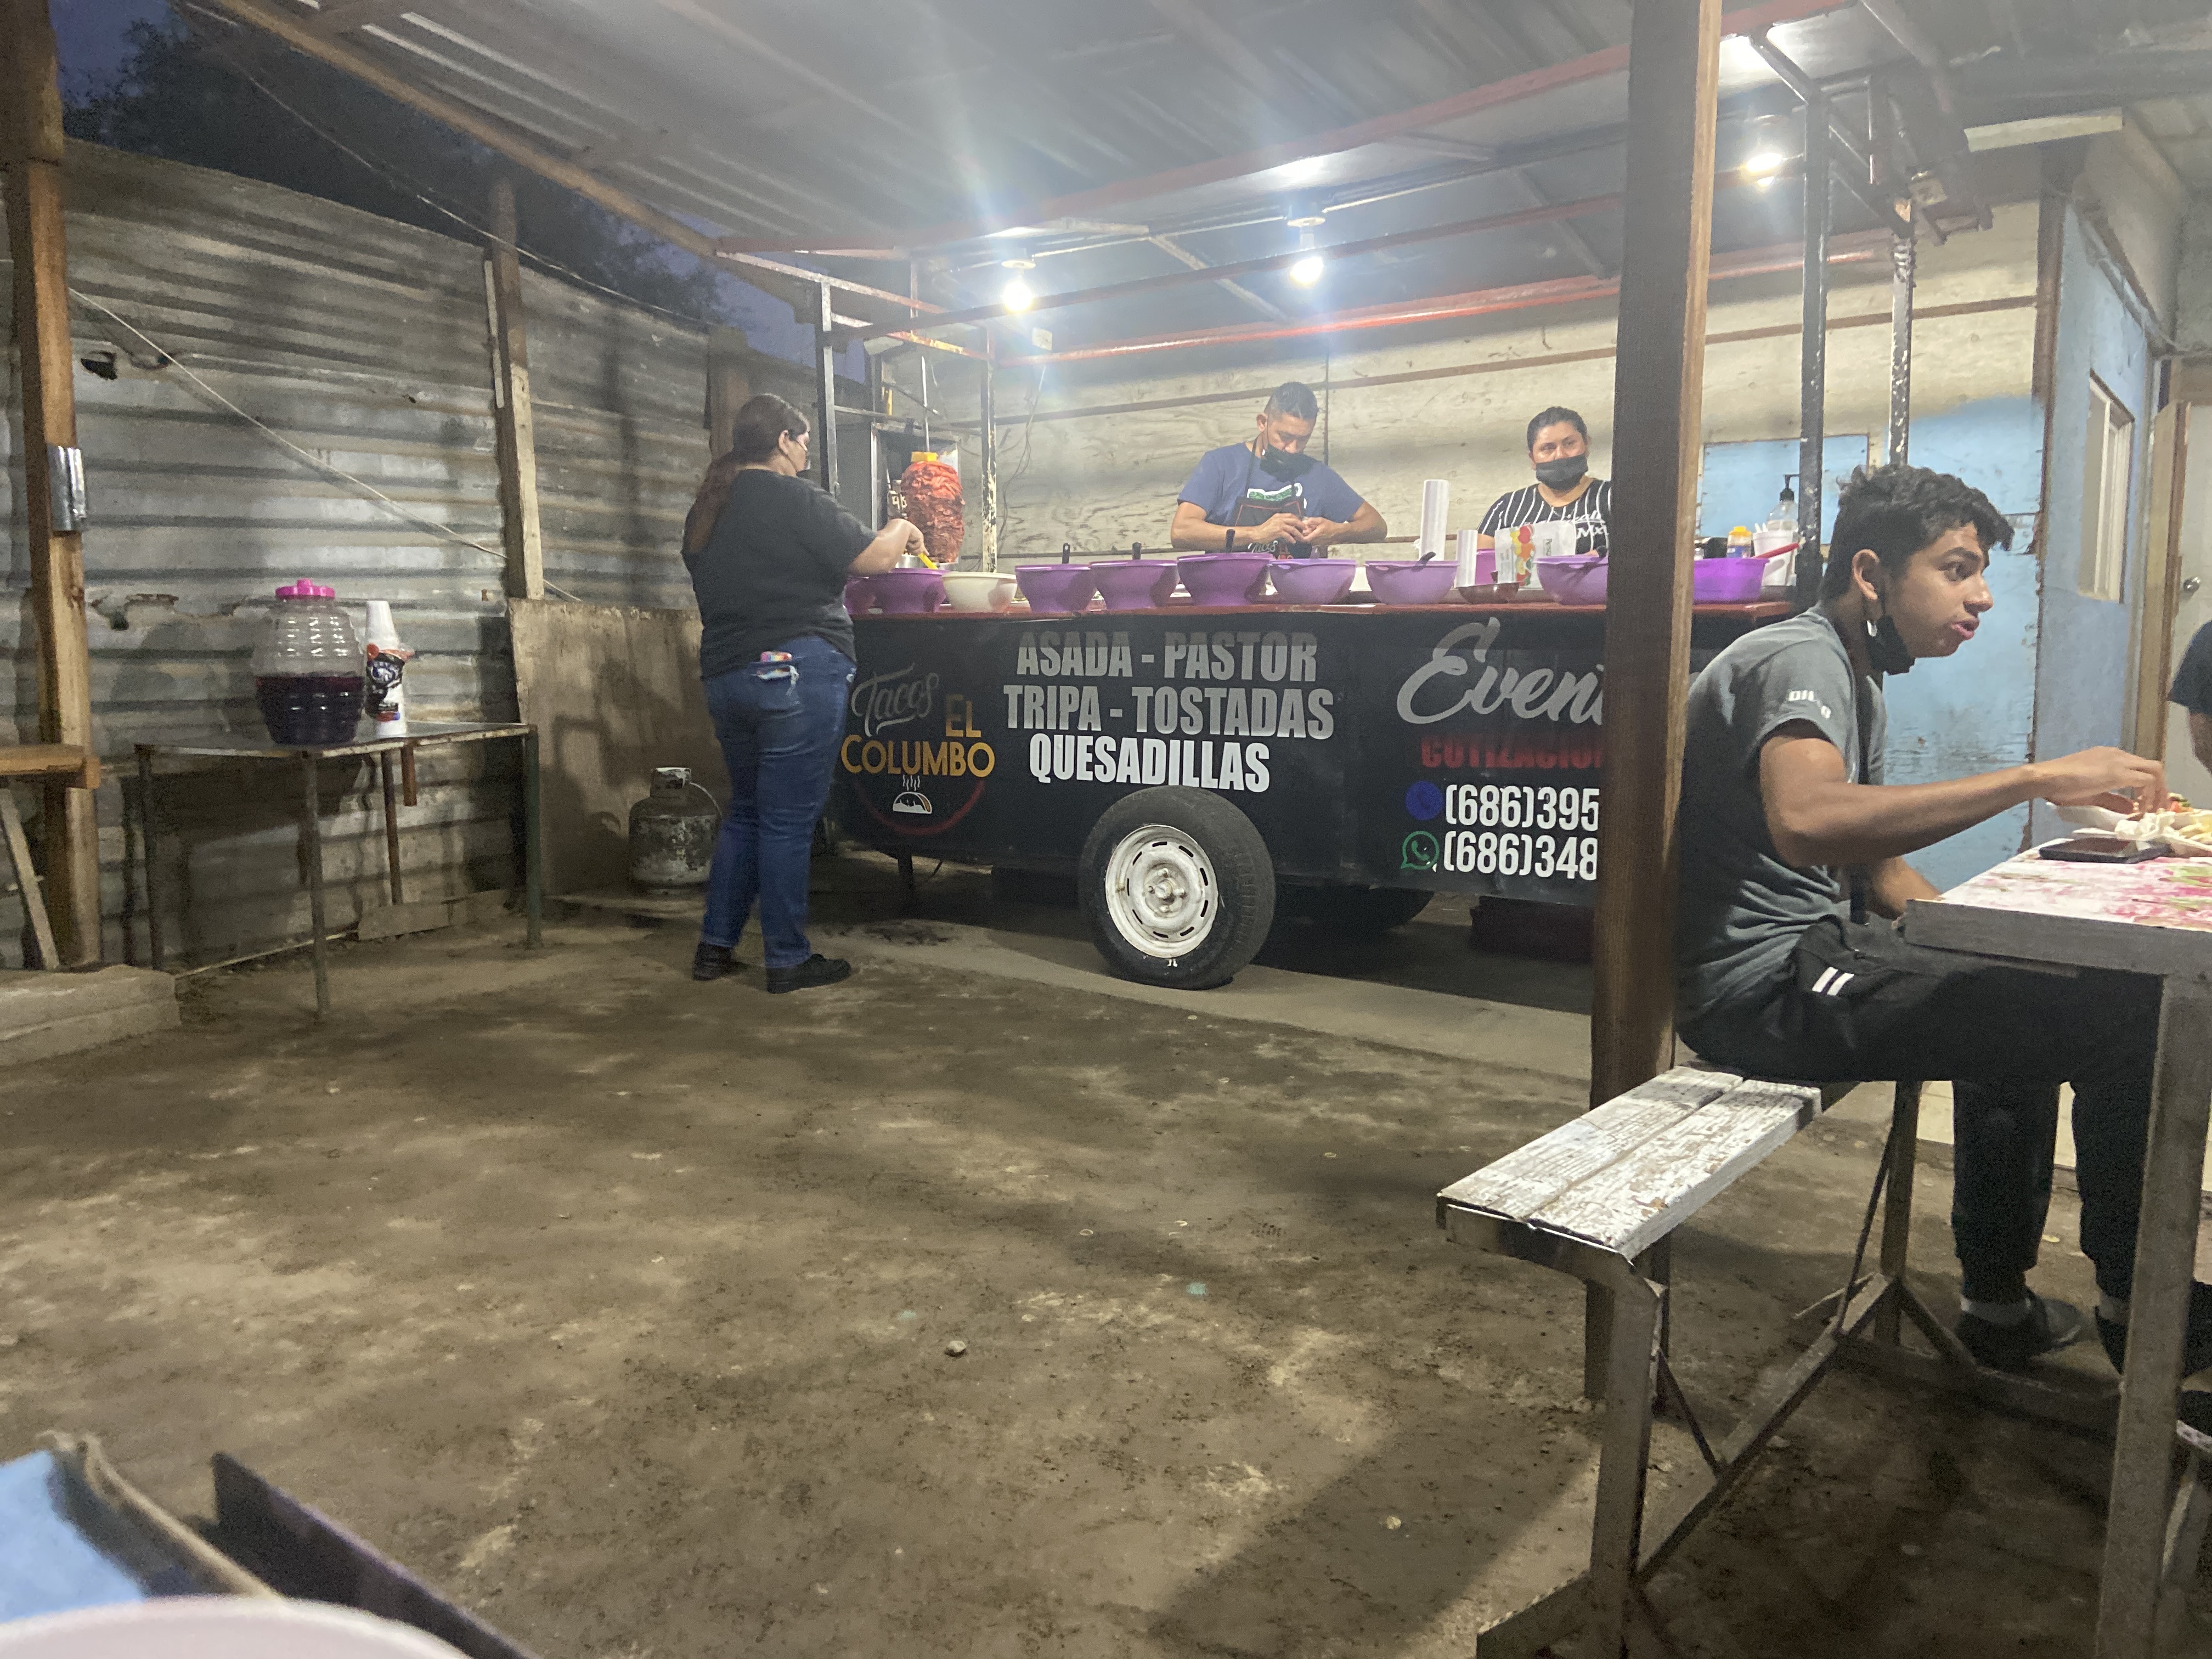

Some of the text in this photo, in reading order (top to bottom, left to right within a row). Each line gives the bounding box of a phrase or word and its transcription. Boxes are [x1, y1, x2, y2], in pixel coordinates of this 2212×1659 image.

[1017, 631, 1317, 681] ASADA - PASTOR
[851, 662, 940, 737] Tacos
[945, 693, 981, 737] EL
[1003, 685, 1334, 740] TRIPA - TOSTADAS
[840, 735, 995, 777] COLUMBO
[1030, 733, 1270, 793] QUESADILLAS
